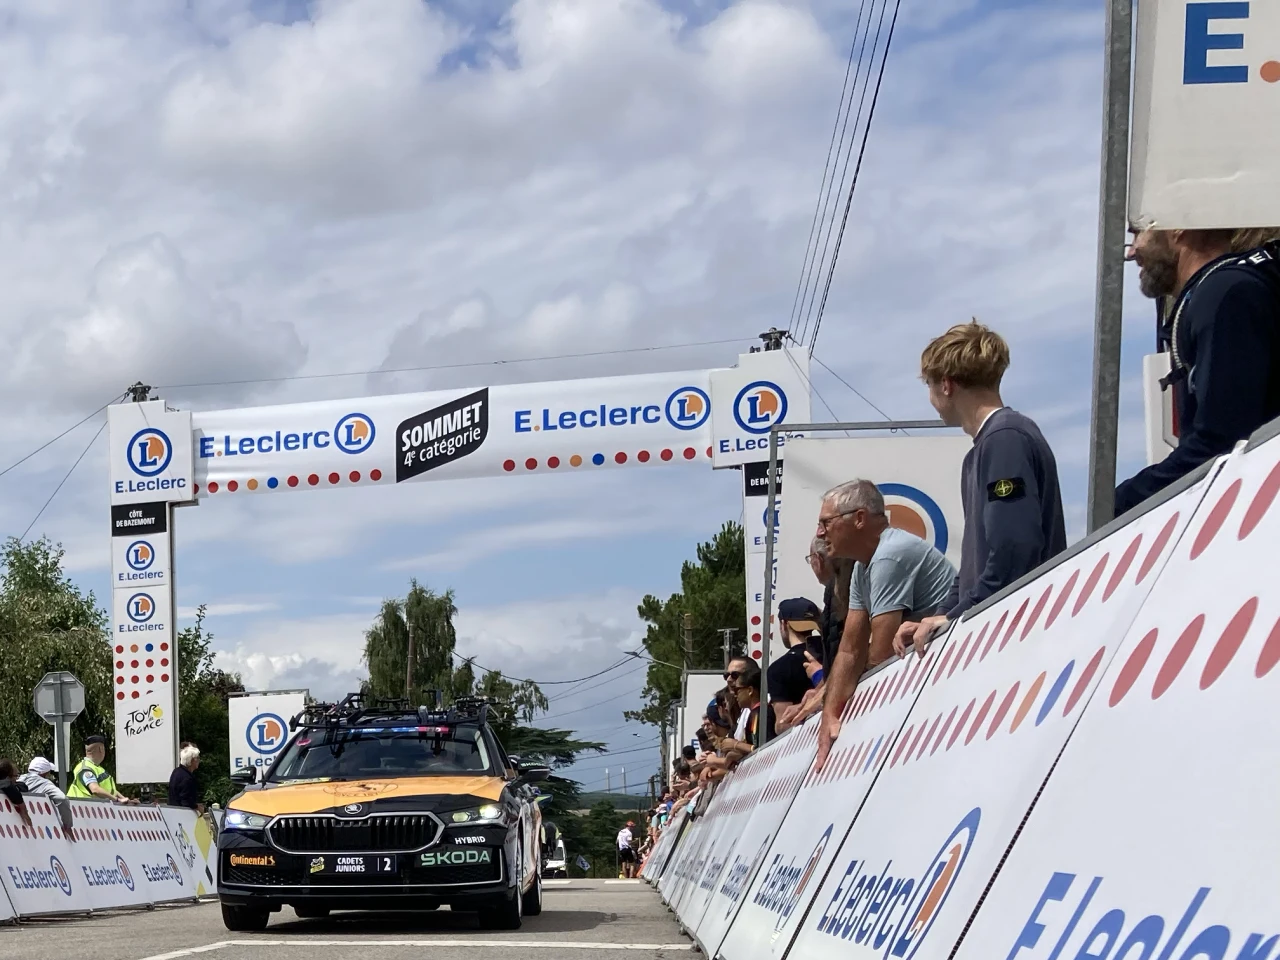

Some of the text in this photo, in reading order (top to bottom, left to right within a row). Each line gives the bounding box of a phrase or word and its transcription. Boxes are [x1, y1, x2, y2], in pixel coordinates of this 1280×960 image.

[515, 404, 660, 433] E.Leclerc
[402, 401, 482, 452] SOMMET
[199, 430, 330, 458] E.Leclerc
[420, 427, 481, 461] catégorie
[115, 477, 186, 493] E.Leclerc
[124, 518, 155, 526] BAZEMONT
[119, 571, 164, 581] E.Leclerc
[119, 623, 164, 633] E.Leclerc
[455, 836, 486, 844] HYBRID
[231, 854, 267, 866] Continental
[337, 857, 363, 865] CADETS
[384, 858, 391, 871] 2
[816, 860, 915, 950] E.Leclerc
